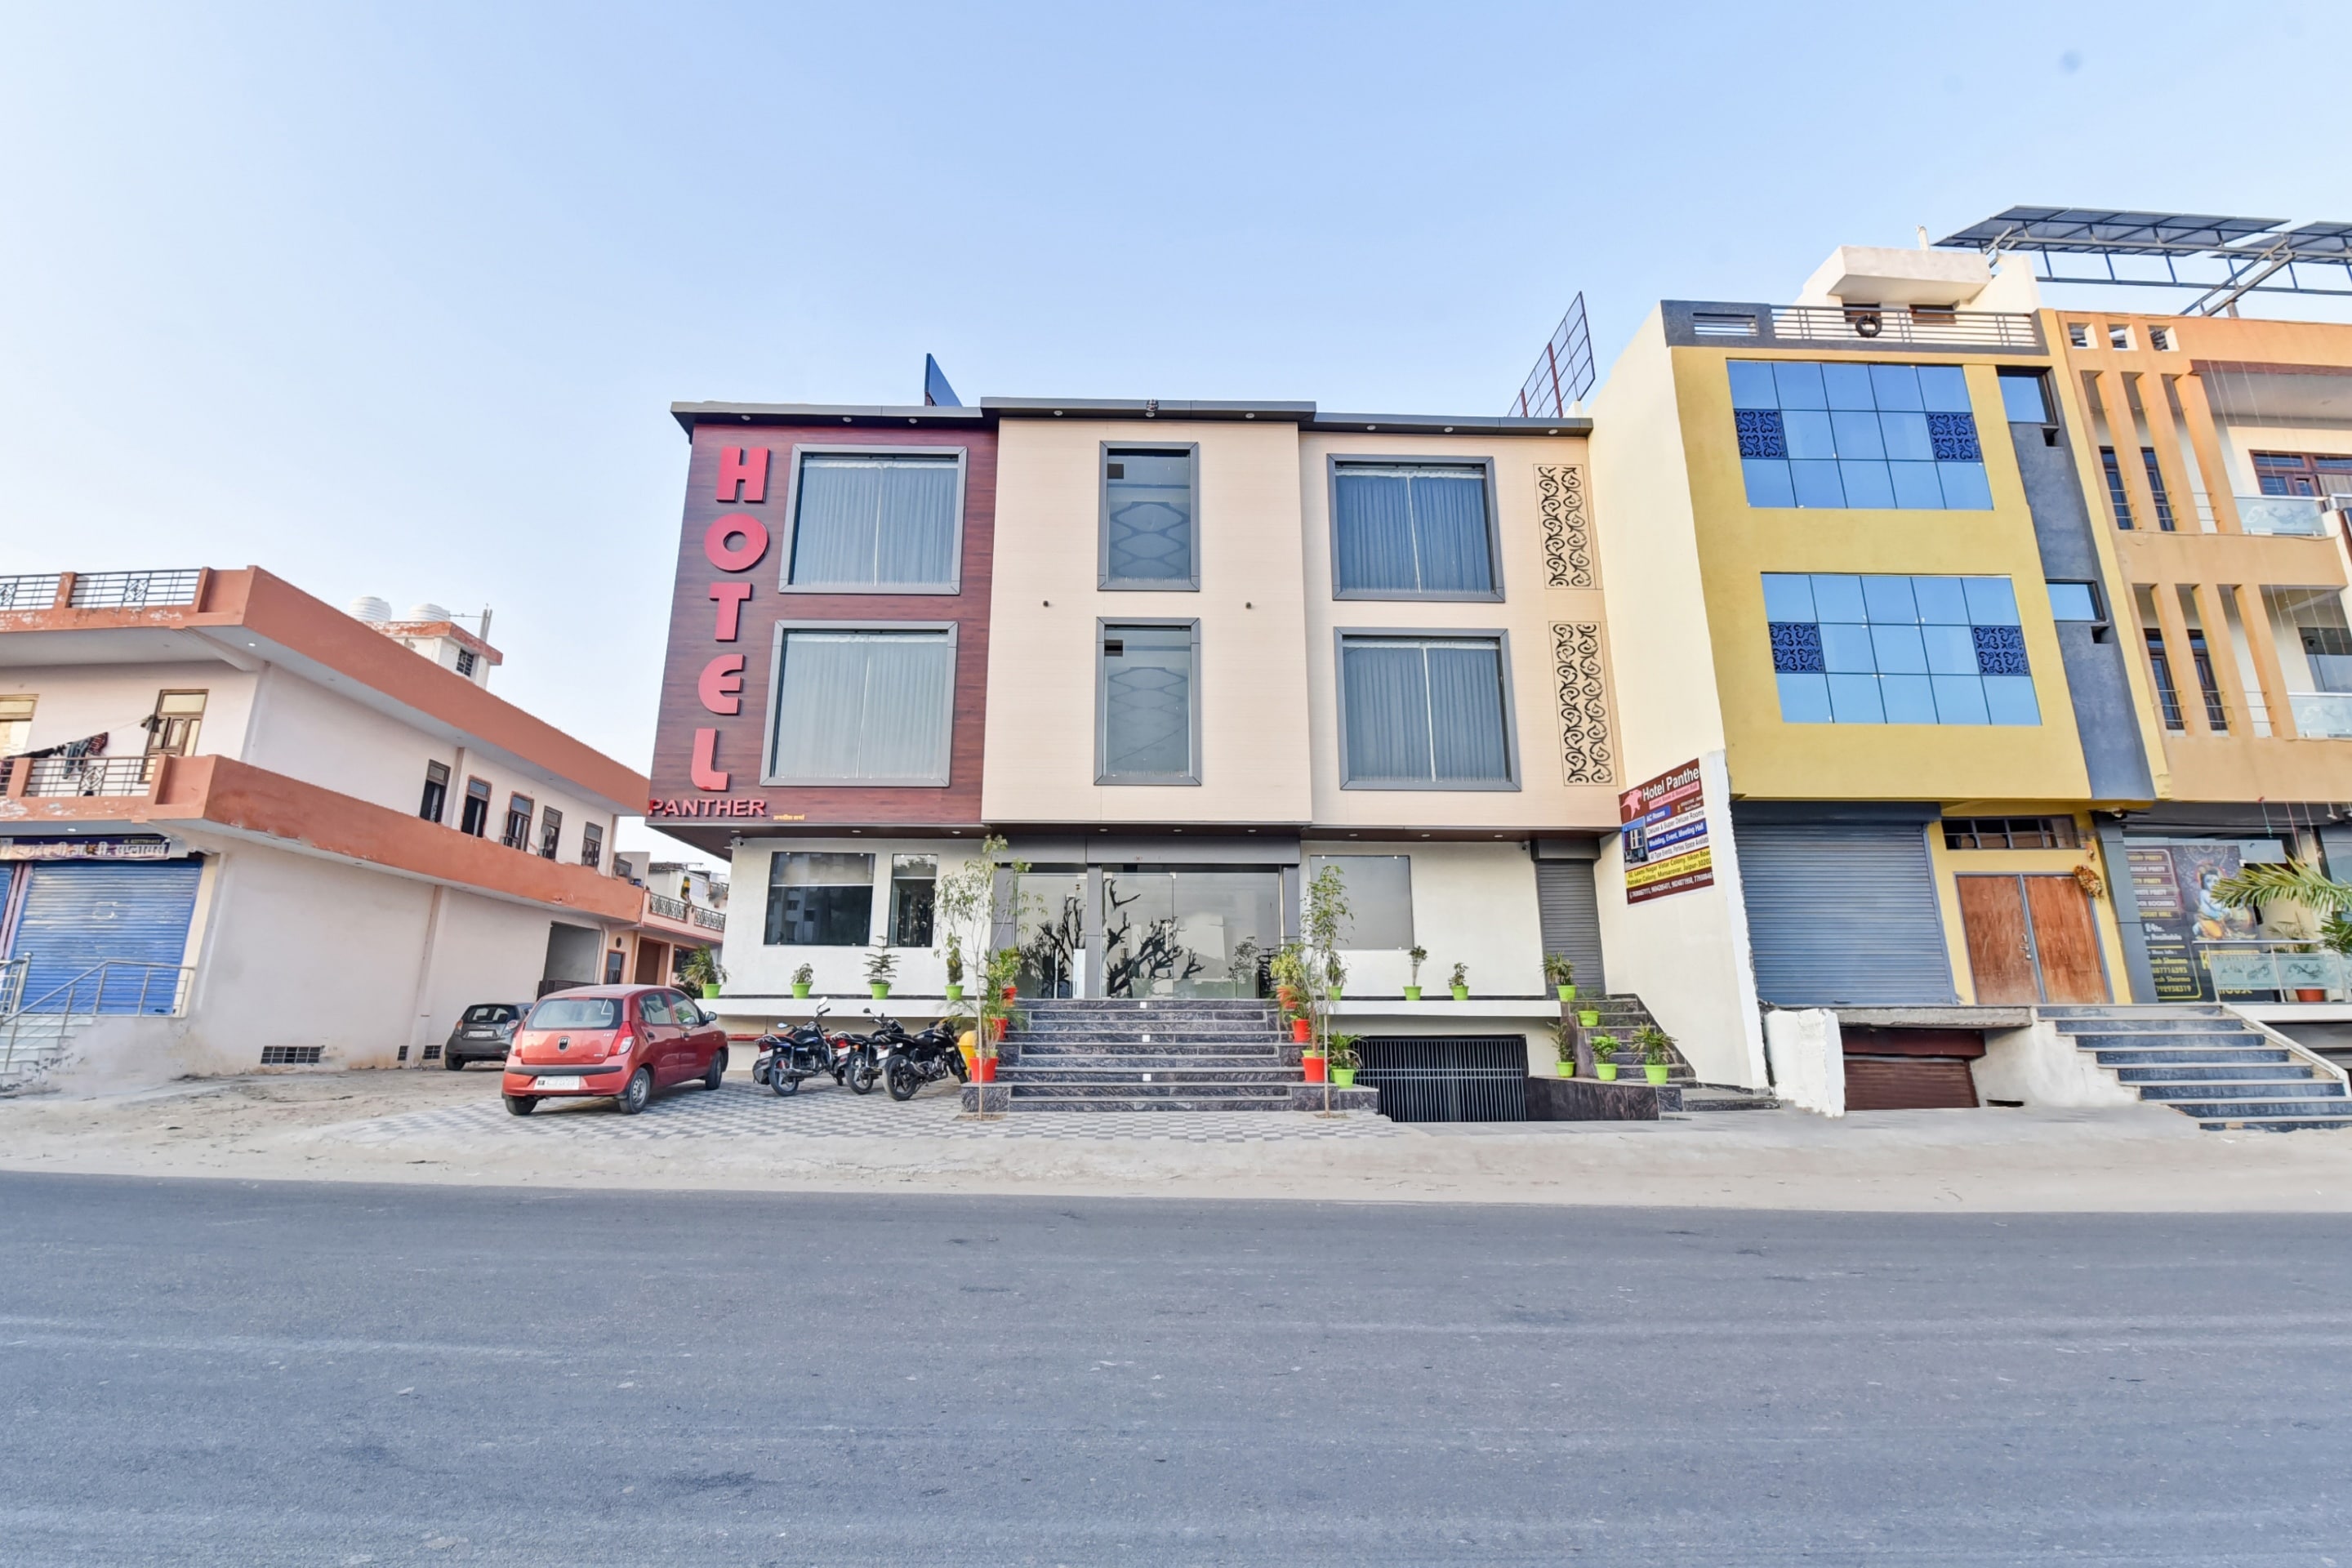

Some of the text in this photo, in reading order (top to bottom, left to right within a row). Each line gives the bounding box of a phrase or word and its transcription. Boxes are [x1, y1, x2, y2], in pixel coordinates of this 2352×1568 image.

[690, 447, 769, 792] HOTEL
[1642, 779, 1665, 802] Hotel
[1666, 768, 1699, 791] Panthe
[648, 798, 766, 817] PANTHER
[1675, 816, 1689, 824] Deluxe
[1690, 809, 1704, 818] Rooms
[1678, 826, 1695, 838] Meeting
[1695, 822, 1704, 832] Hall
